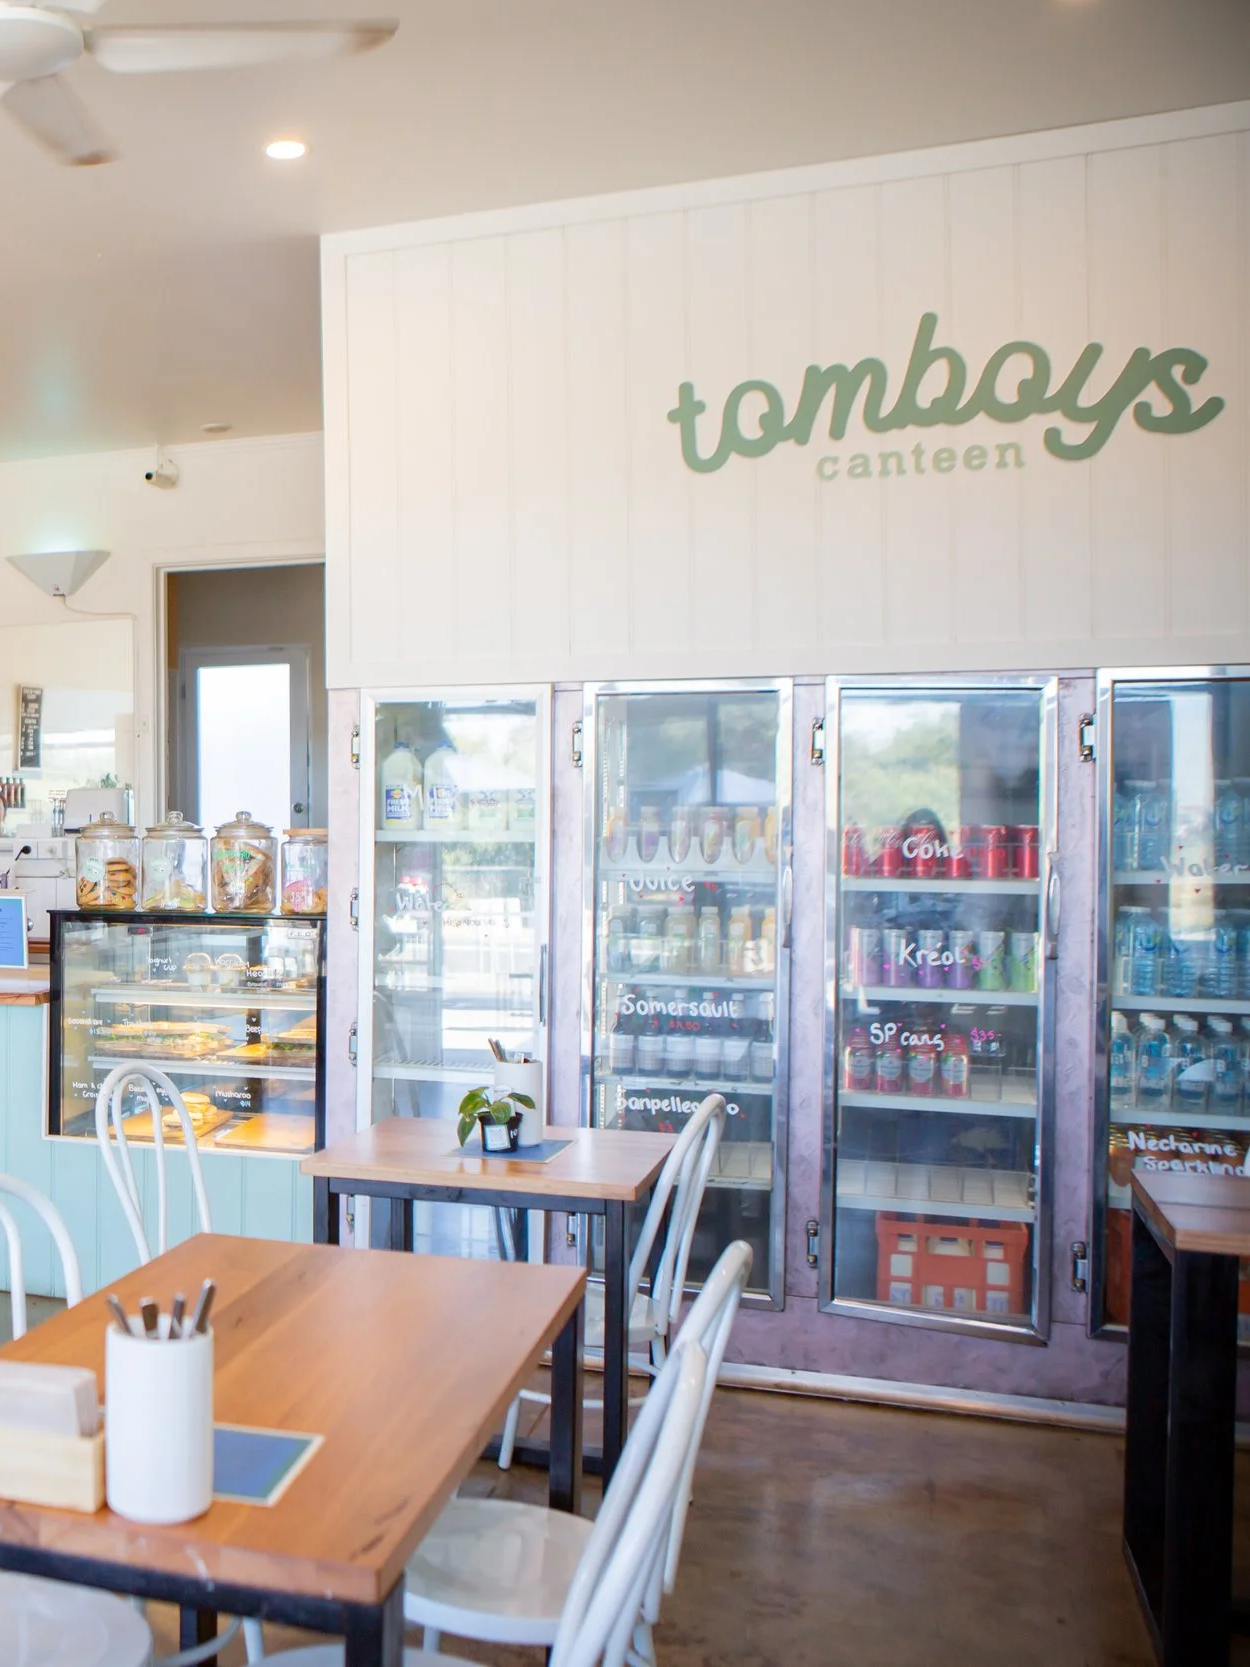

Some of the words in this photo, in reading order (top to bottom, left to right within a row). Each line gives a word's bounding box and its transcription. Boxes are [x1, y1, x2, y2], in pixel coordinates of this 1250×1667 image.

[667, 311, 1225, 474] tomboys
[816, 440, 1026, 481] canteen
[901, 836, 964, 860] Coke
[1160, 855, 1249, 877] Water
[629, 869, 695, 892] Juice
[621, 993, 739, 1018] Somersault
[870, 1022, 898, 1044] SP
[900, 1031, 945, 1052] cans
[72, 1081, 88, 1089] Ham
[128, 1083, 145, 1092] Baco
